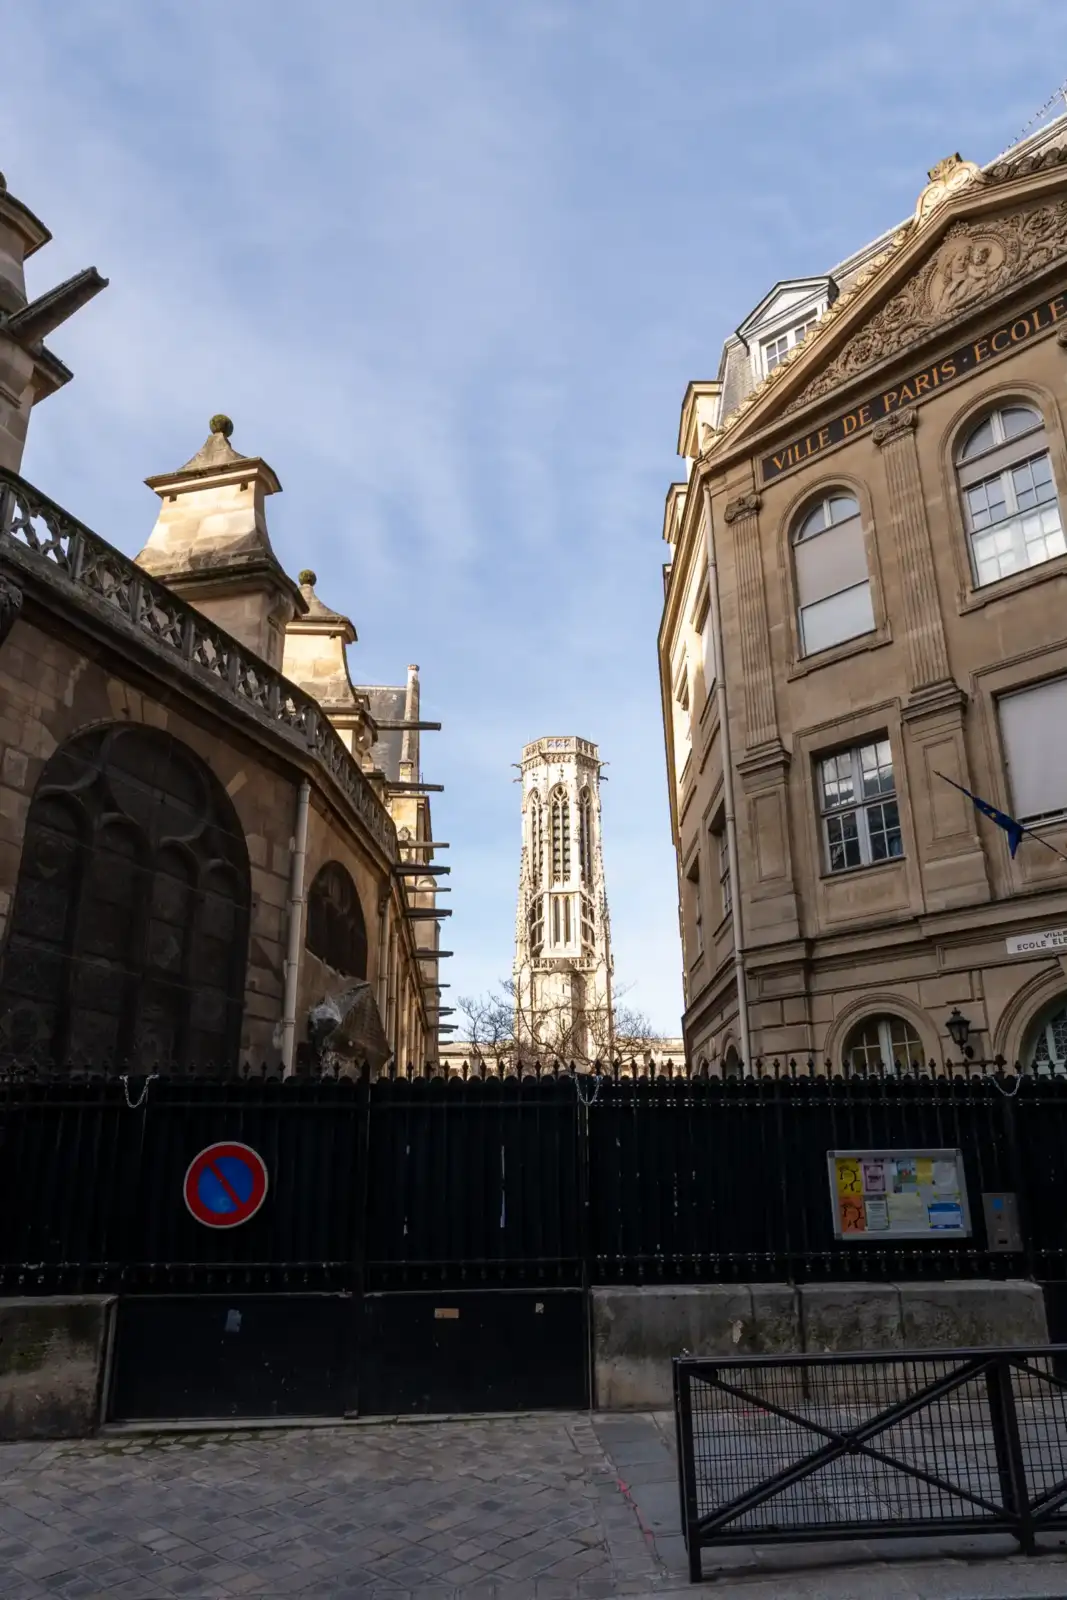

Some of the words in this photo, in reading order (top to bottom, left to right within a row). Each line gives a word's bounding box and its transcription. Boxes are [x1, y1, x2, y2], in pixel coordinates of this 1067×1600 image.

[772, 427, 832, 470] VILLE
[842, 405, 873, 436] DE
[883, 359, 956, 414] PARIS
[1017, 940, 1047, 951] ECOLE
